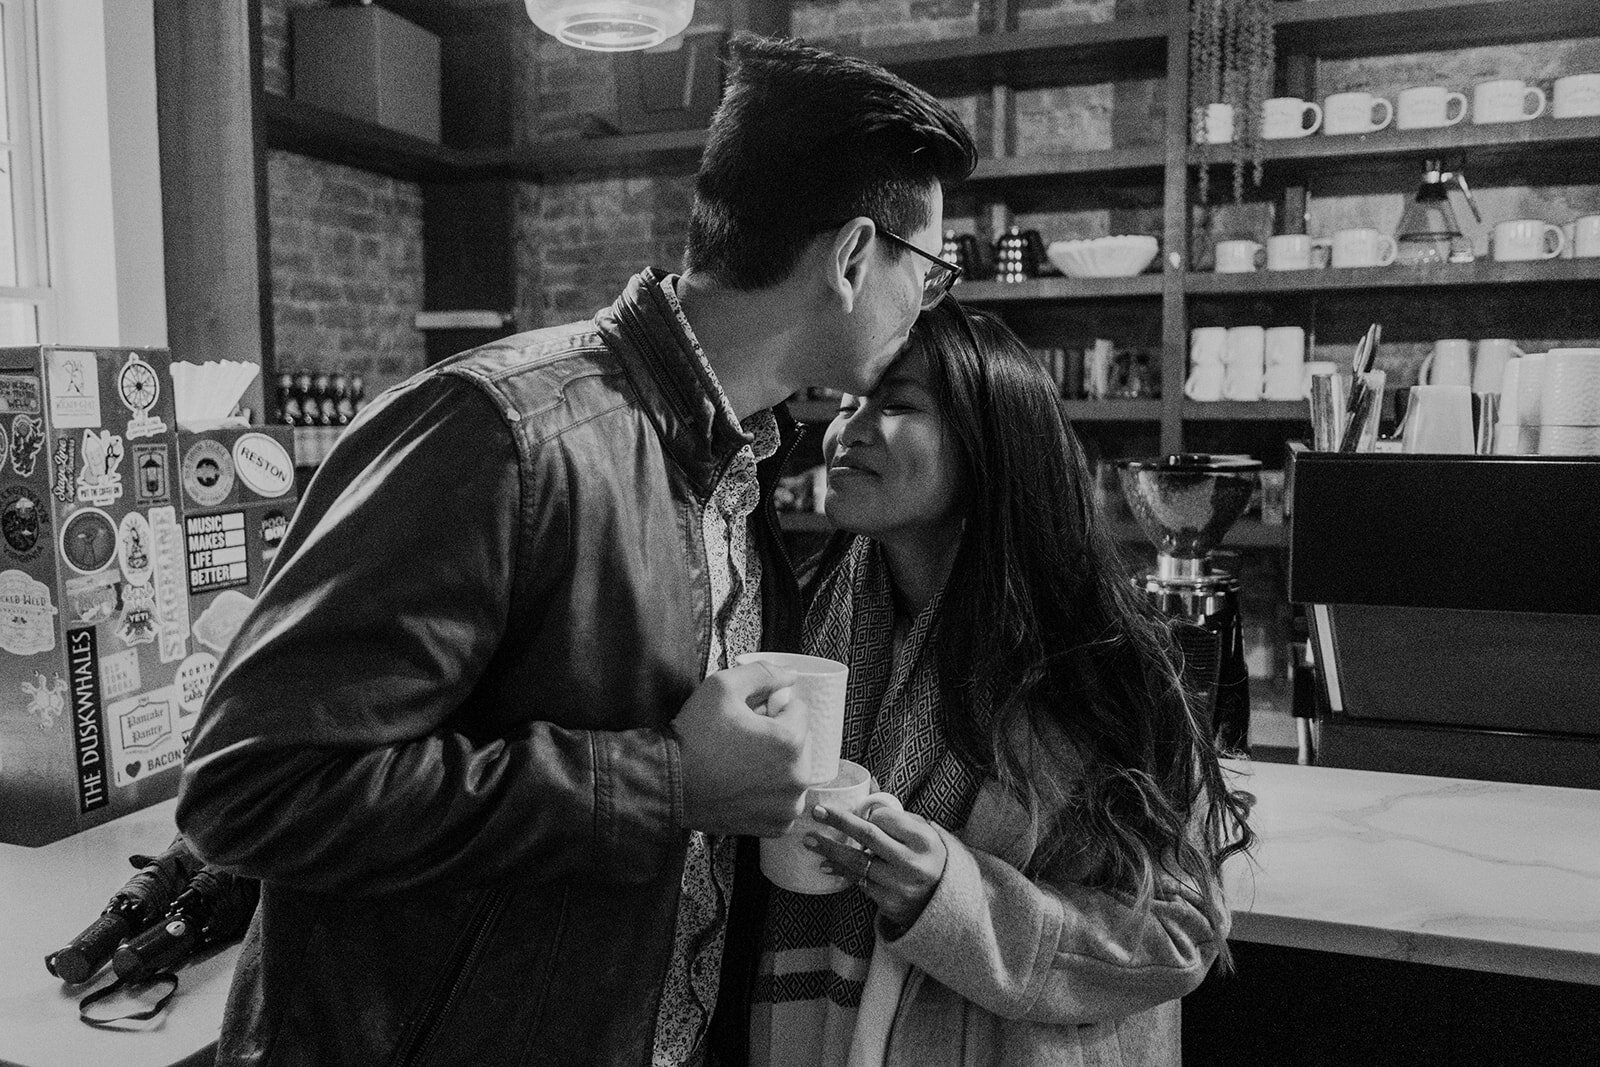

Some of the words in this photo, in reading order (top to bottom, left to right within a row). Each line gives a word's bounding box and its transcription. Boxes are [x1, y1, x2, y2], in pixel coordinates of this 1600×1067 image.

[54, 439, 68, 465] Line
[241, 446, 287, 482] RESTON
[53, 467, 68, 502] Stage
[187, 515, 223, 535] MUSIC
[261, 516, 287, 530] POOL
[188, 531, 226, 553] MAKES
[189, 550, 213, 570] LIFE
[190, 565, 230, 587] BETTER
[22, 594, 46, 607] WEED
[129, 612, 149, 623] YETI
[181, 661, 215, 679] NORTH
[71, 630, 100, 767] DUSKWHALES
[126, 708, 164, 729] Pancake
[131, 724, 164, 743] Pantry
[116, 770, 121, 783] I
[146, 748, 182, 772] BACON
[83, 769, 103, 808] THE
